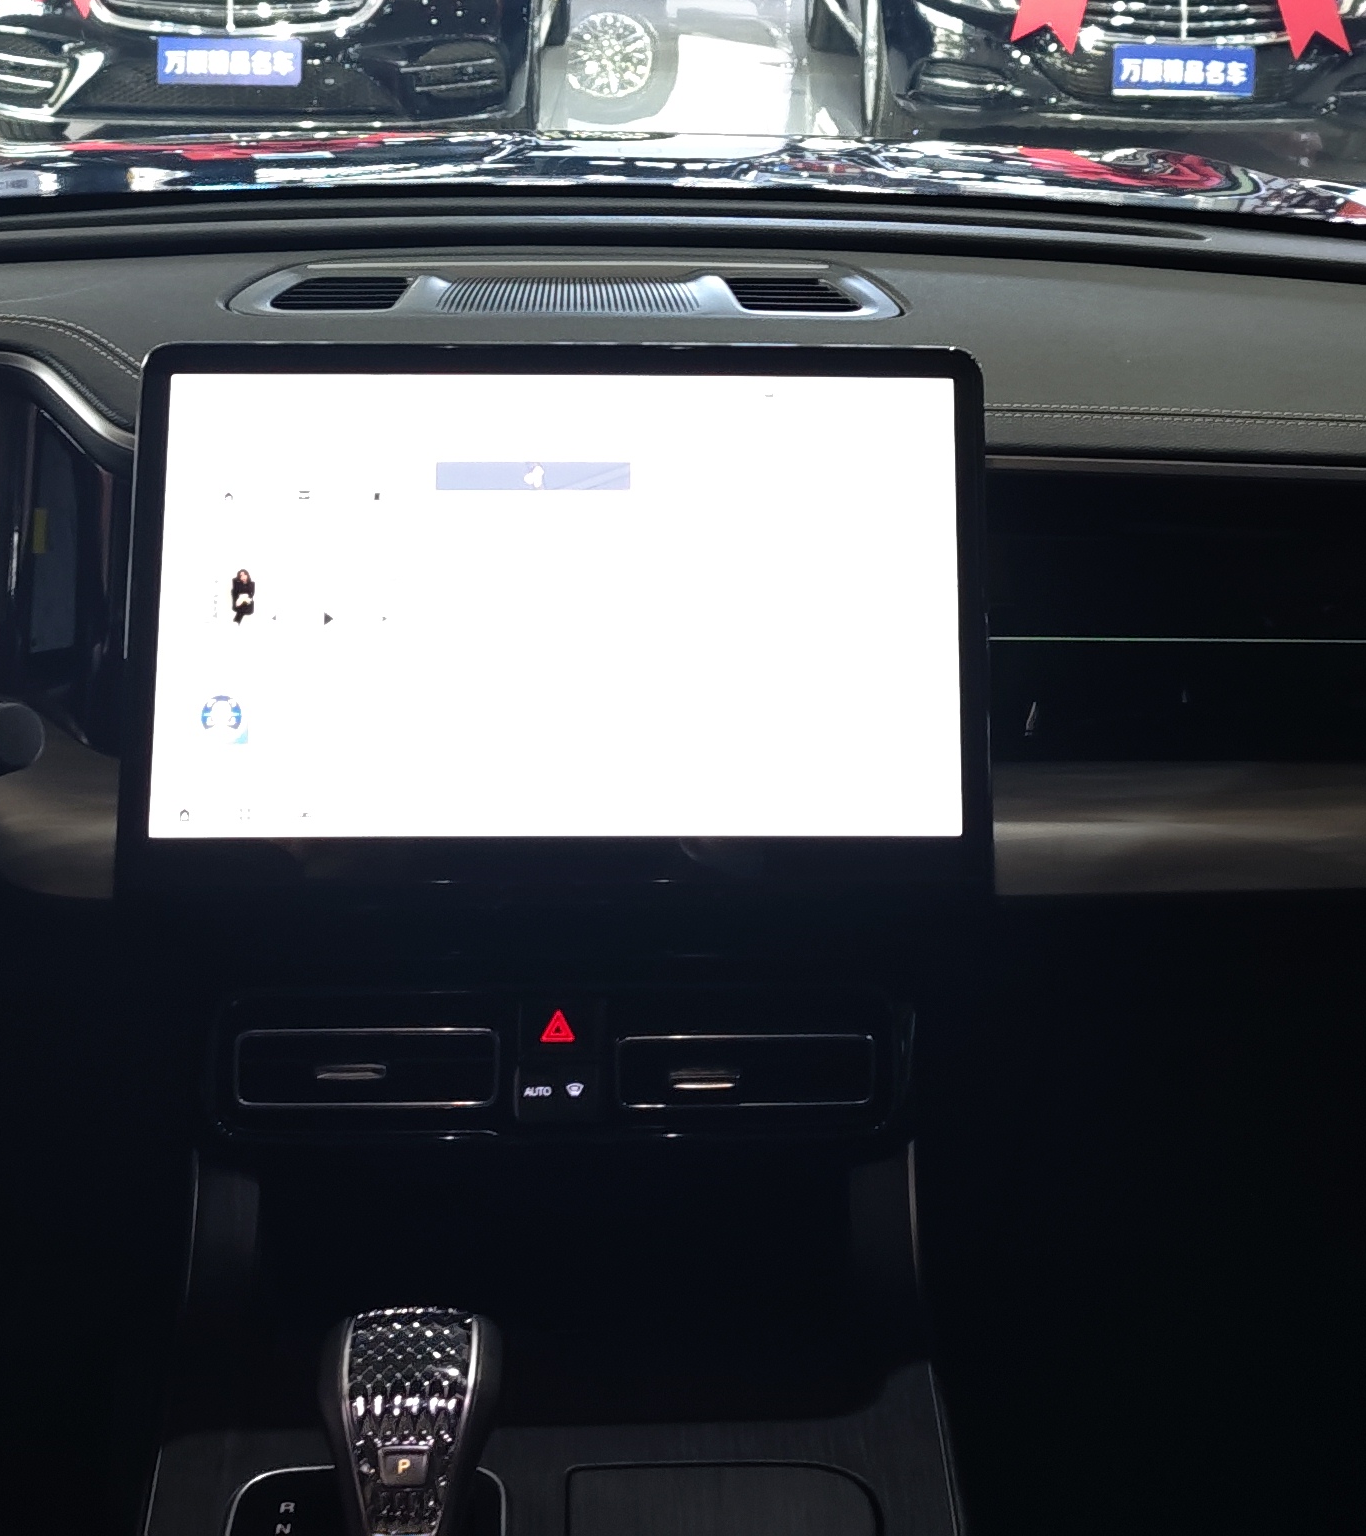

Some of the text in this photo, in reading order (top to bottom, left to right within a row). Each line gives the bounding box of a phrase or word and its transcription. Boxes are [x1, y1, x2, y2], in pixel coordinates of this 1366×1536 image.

[523, 1086, 553, 1098] AUTO
[397, 1458, 411, 1475] P
[279, 1502, 295, 1513] R
[275, 1523, 292, 1535] N
